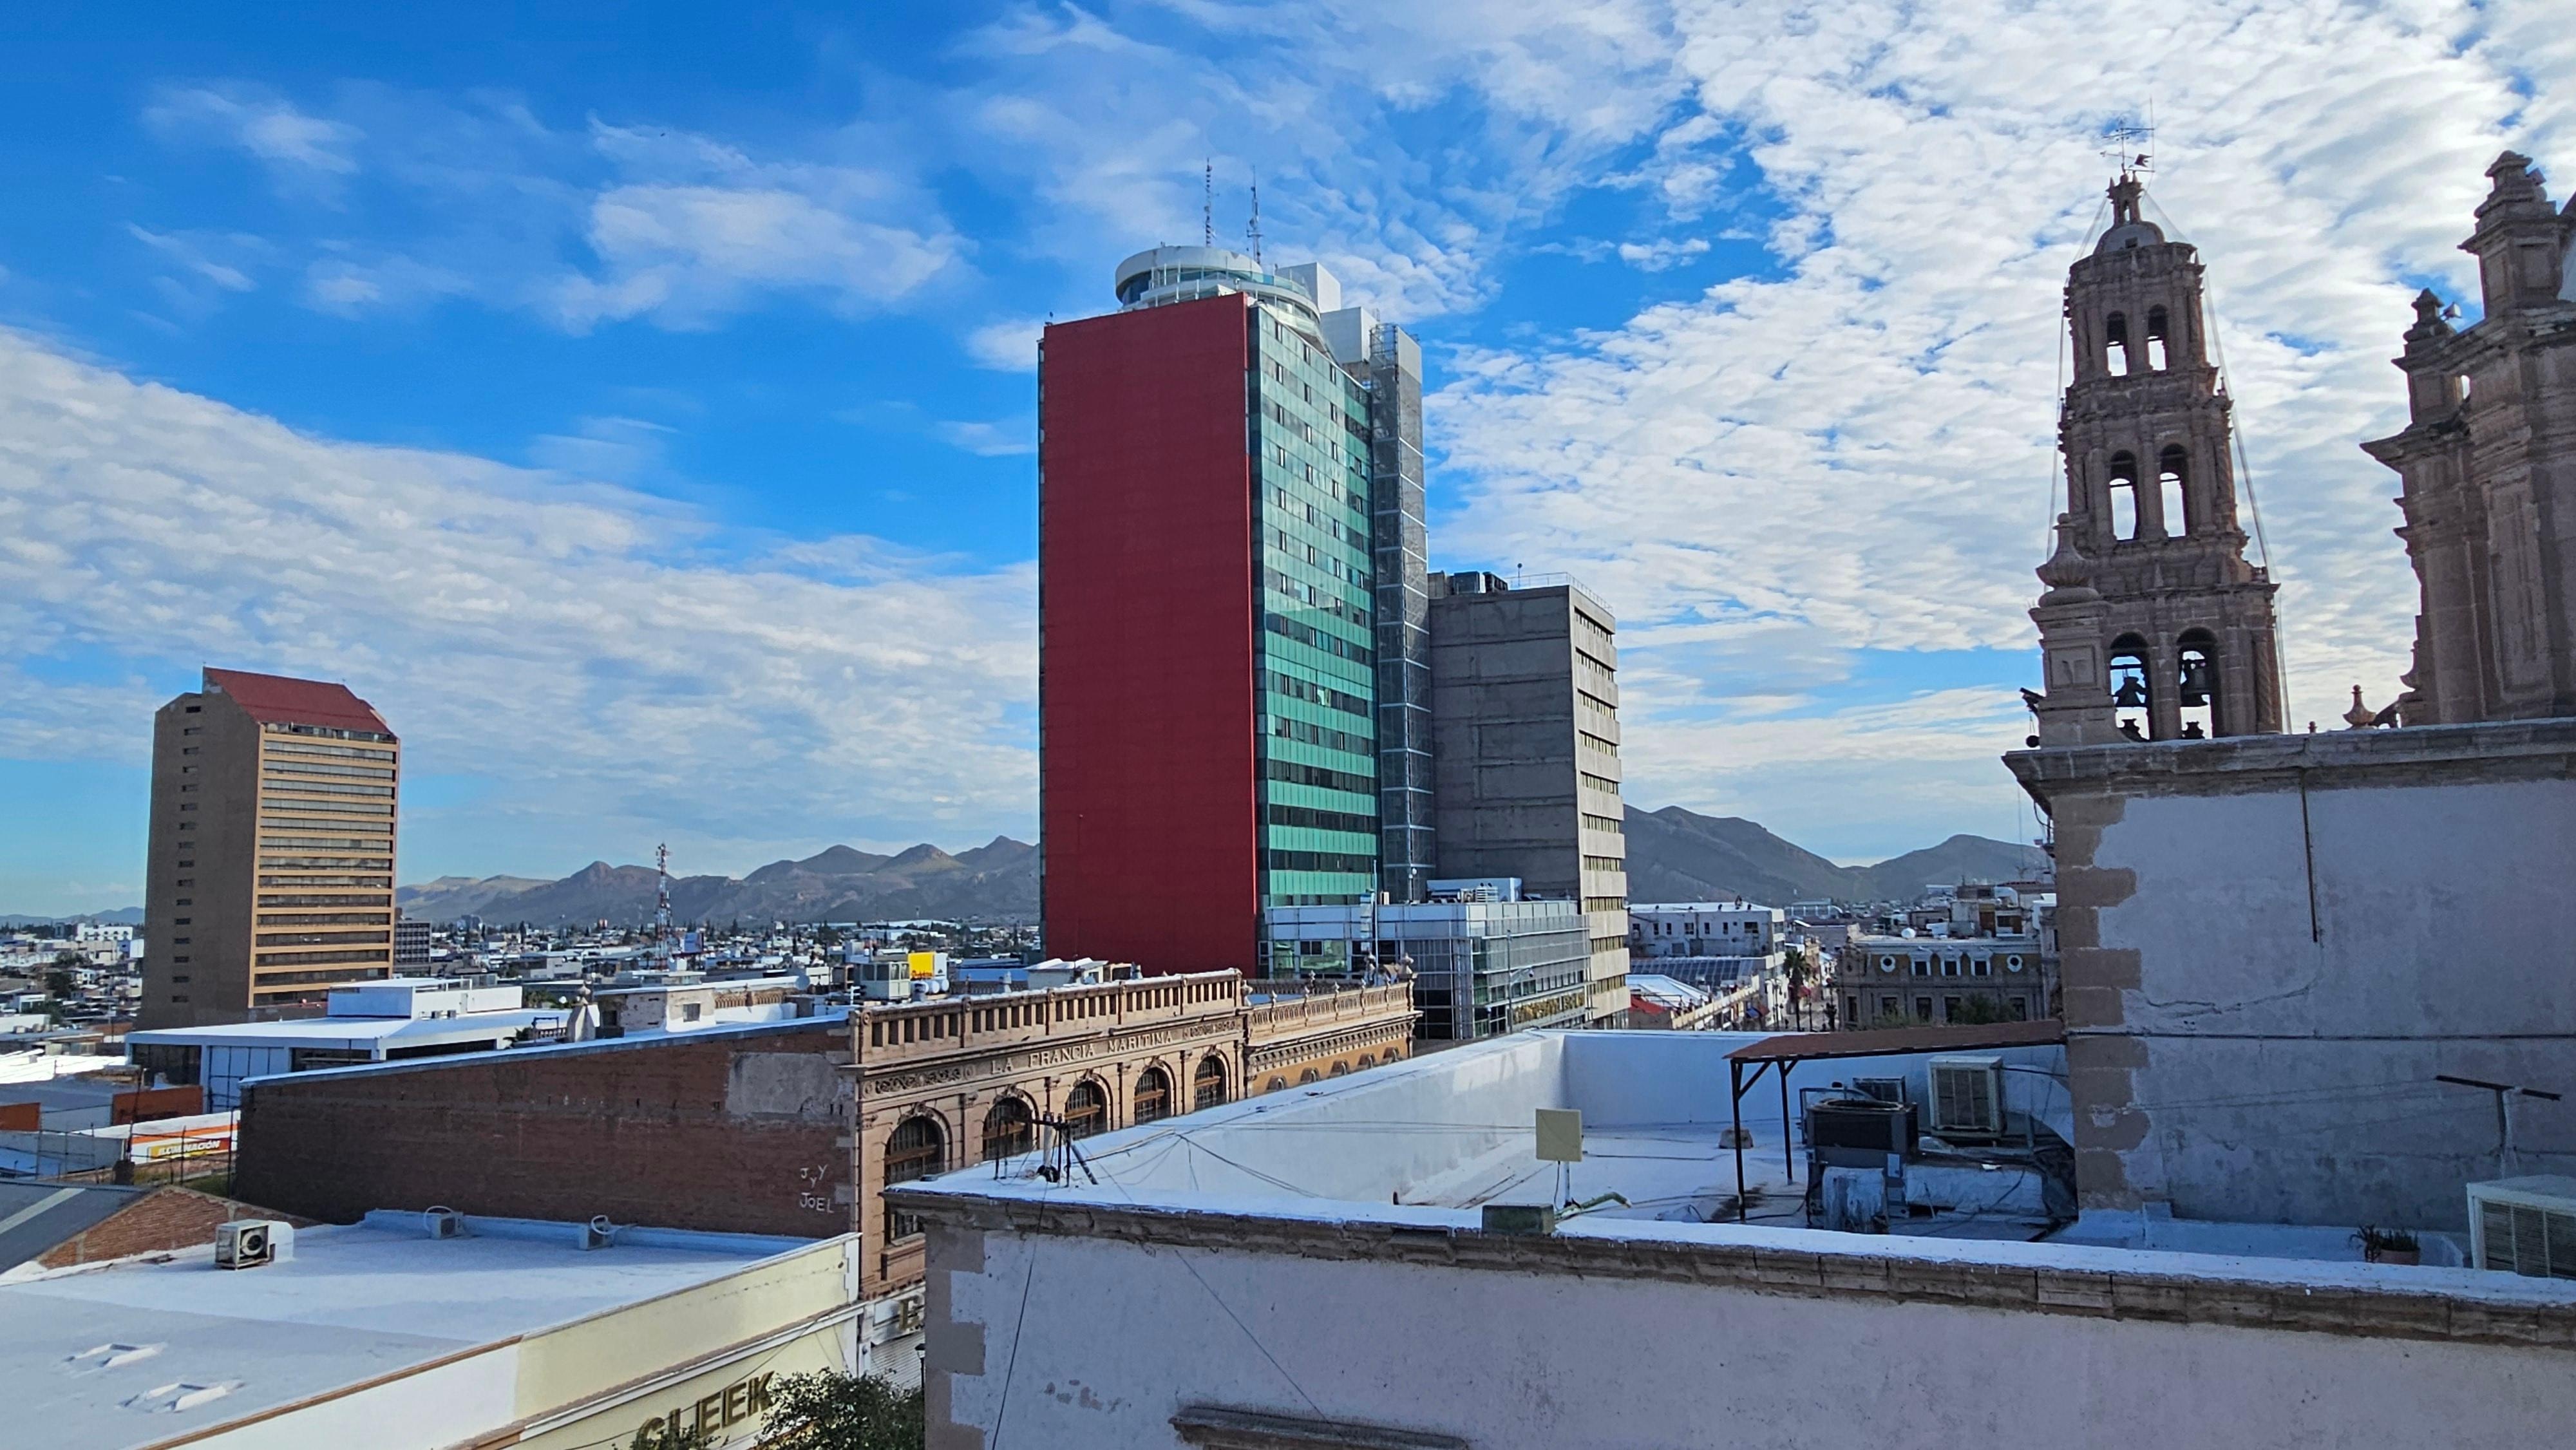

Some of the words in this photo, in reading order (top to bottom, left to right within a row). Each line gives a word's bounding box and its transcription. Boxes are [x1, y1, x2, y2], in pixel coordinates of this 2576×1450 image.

[990, 1057, 1014, 1075] LA
[1028, 1042, 1095, 1068] FRANCIA
[1108, 1030, 1173, 1053] MARITIMA
[158, 1140, 221, 1155] ILUMNACIÓN
[799, 1192, 835, 1214] JOEL
